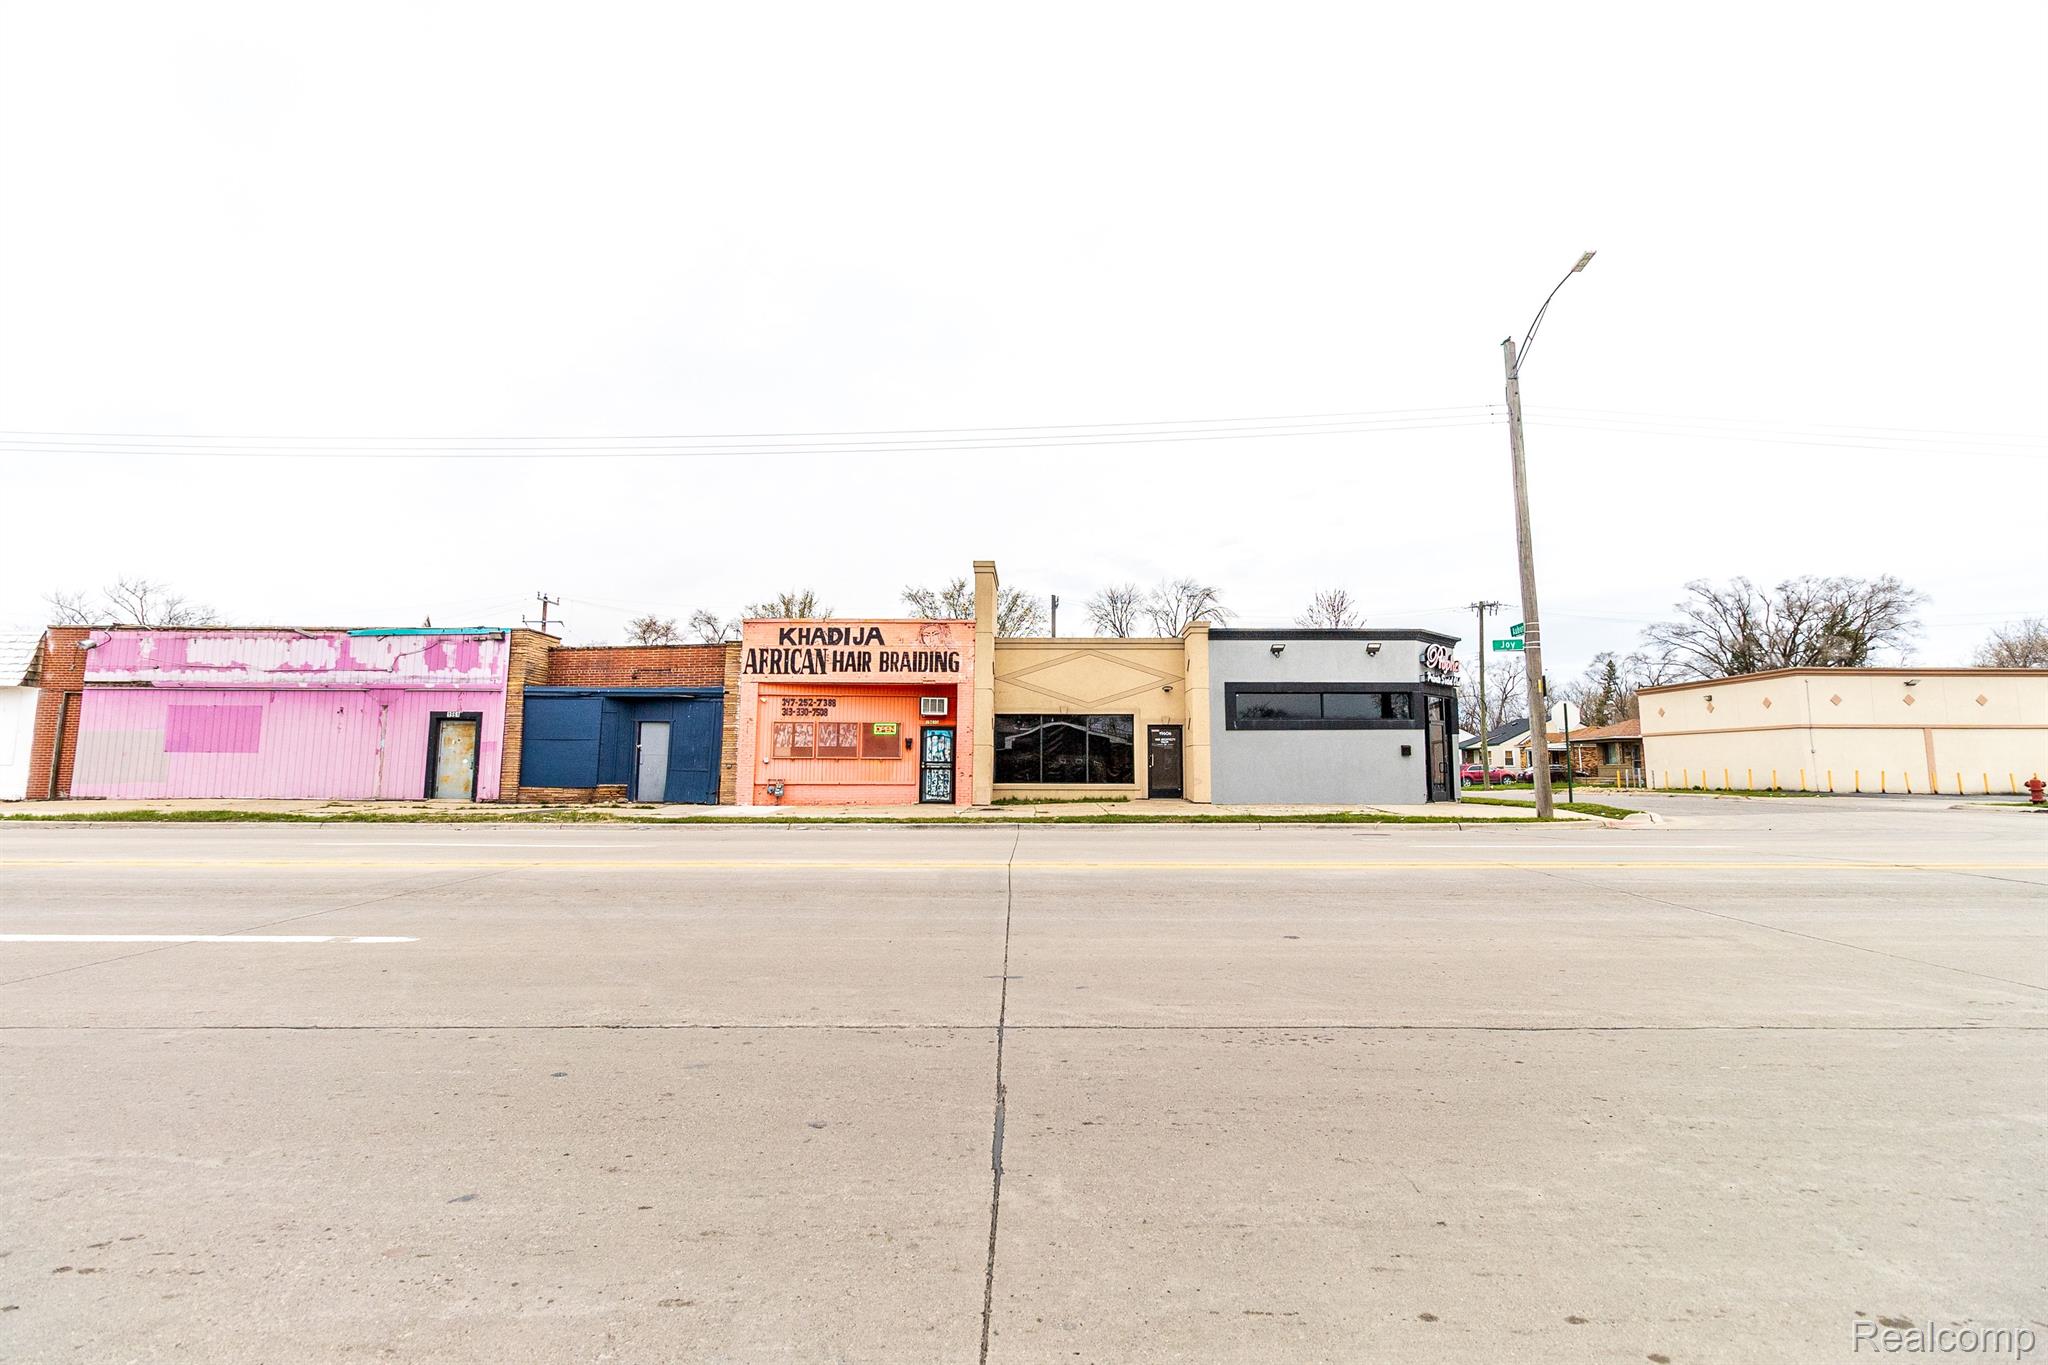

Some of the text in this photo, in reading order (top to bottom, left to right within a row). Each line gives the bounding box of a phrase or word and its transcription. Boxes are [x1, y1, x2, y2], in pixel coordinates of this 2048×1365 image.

[779, 627, 885, 646] KHADIJA
[1500, 641, 1516, 650] Joy
[743, 648, 960, 674] AFRICAN HAIR BRAIDING
[875, 725, 896, 733] OPEN
